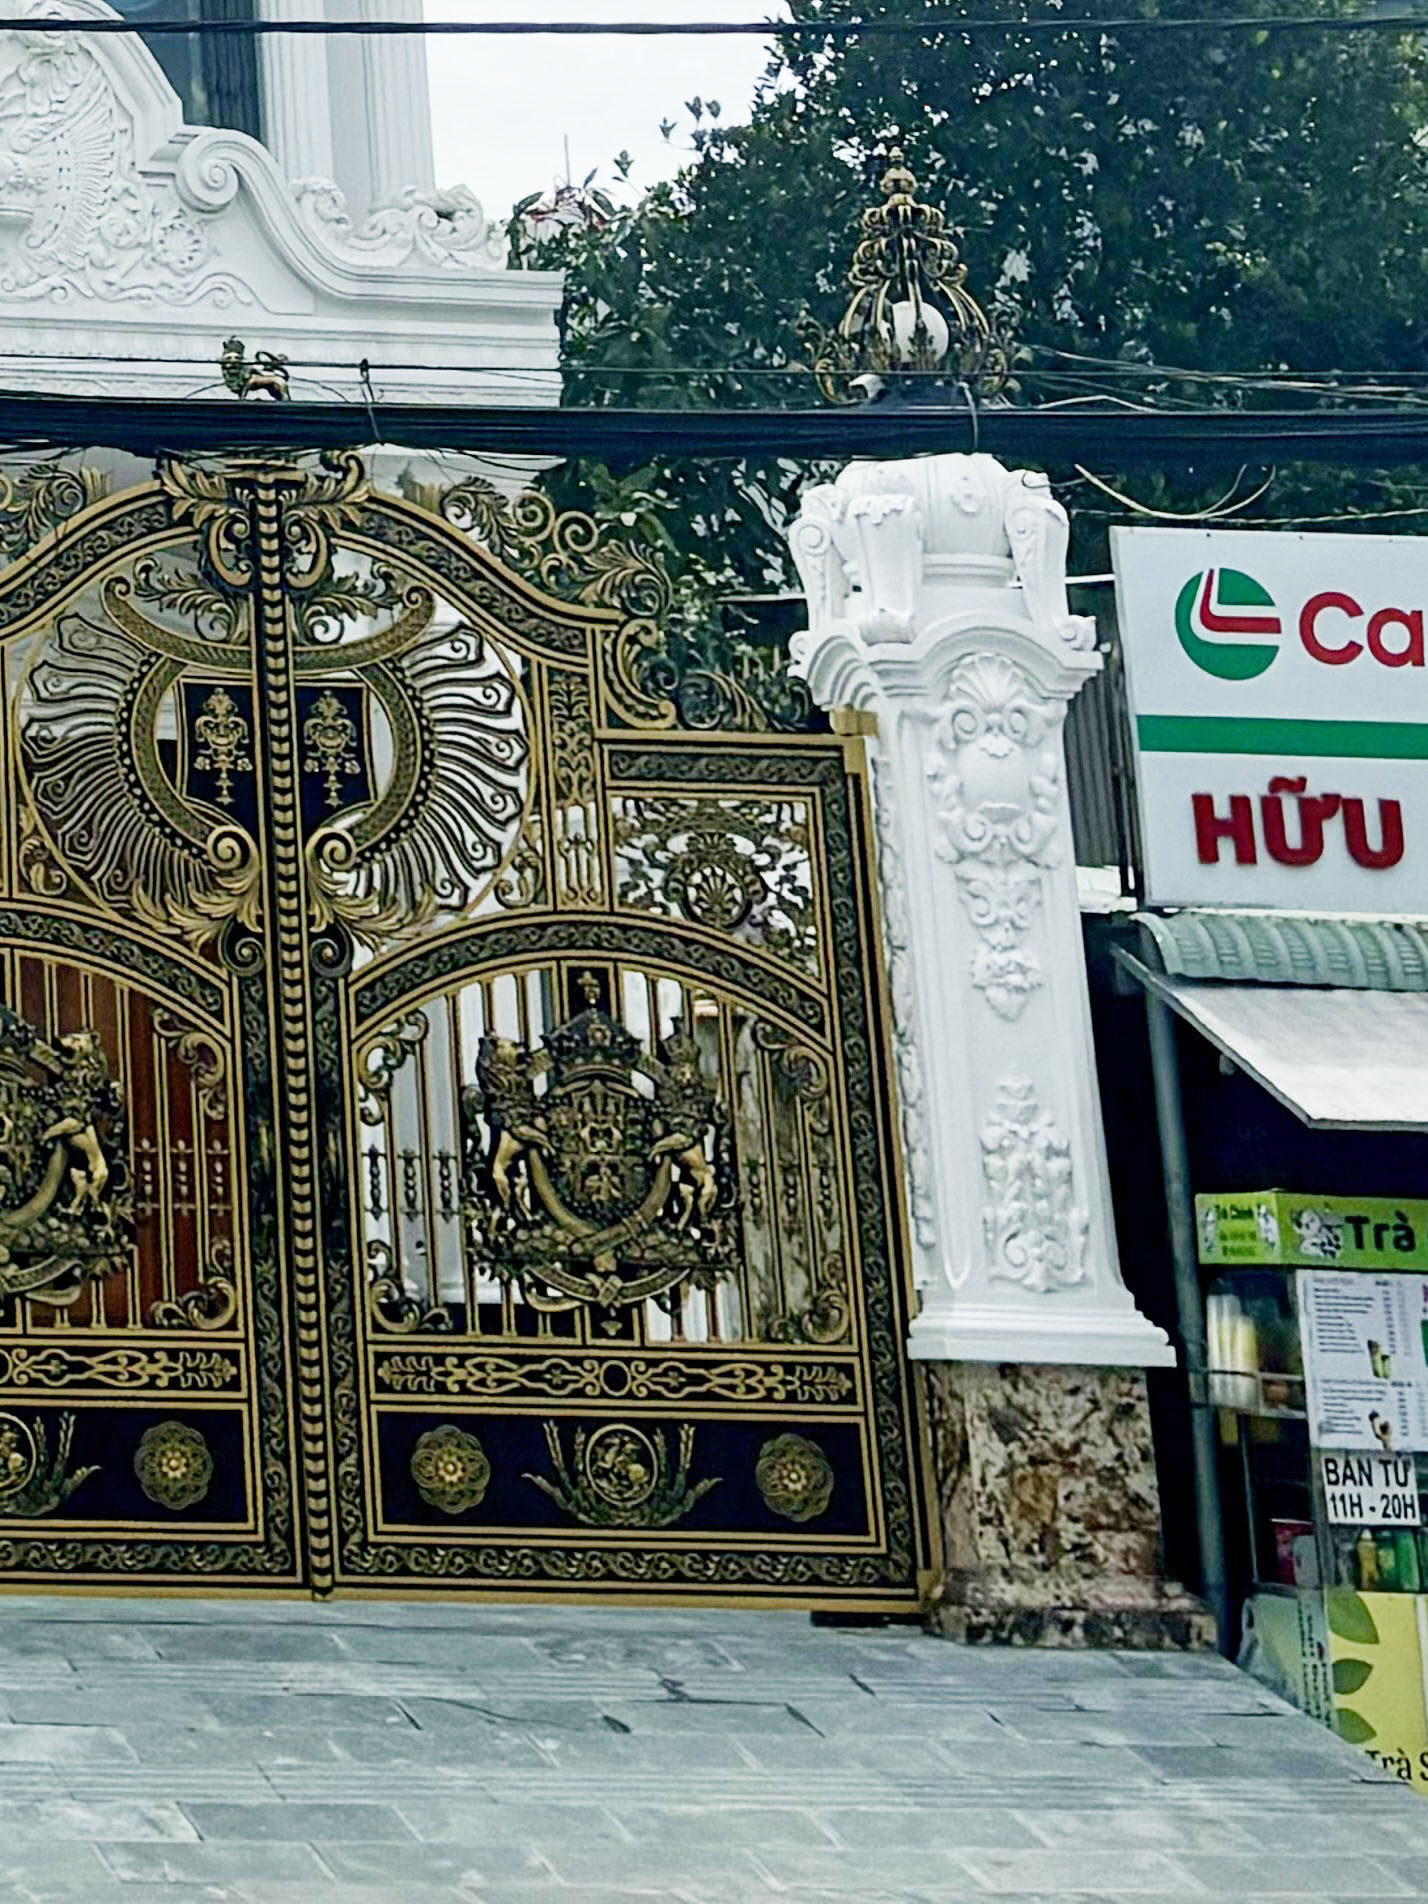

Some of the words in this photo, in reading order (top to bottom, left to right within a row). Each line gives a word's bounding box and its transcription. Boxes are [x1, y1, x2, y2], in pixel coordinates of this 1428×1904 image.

[1298, 591, 1426, 668] Ca
[1191, 774, 1405, 870] HỮU
[1344, 1209, 1417, 1253] Trà
[1330, 1493, 1364, 1519] 11H
[1381, 1493, 1417, 1520] 20H
